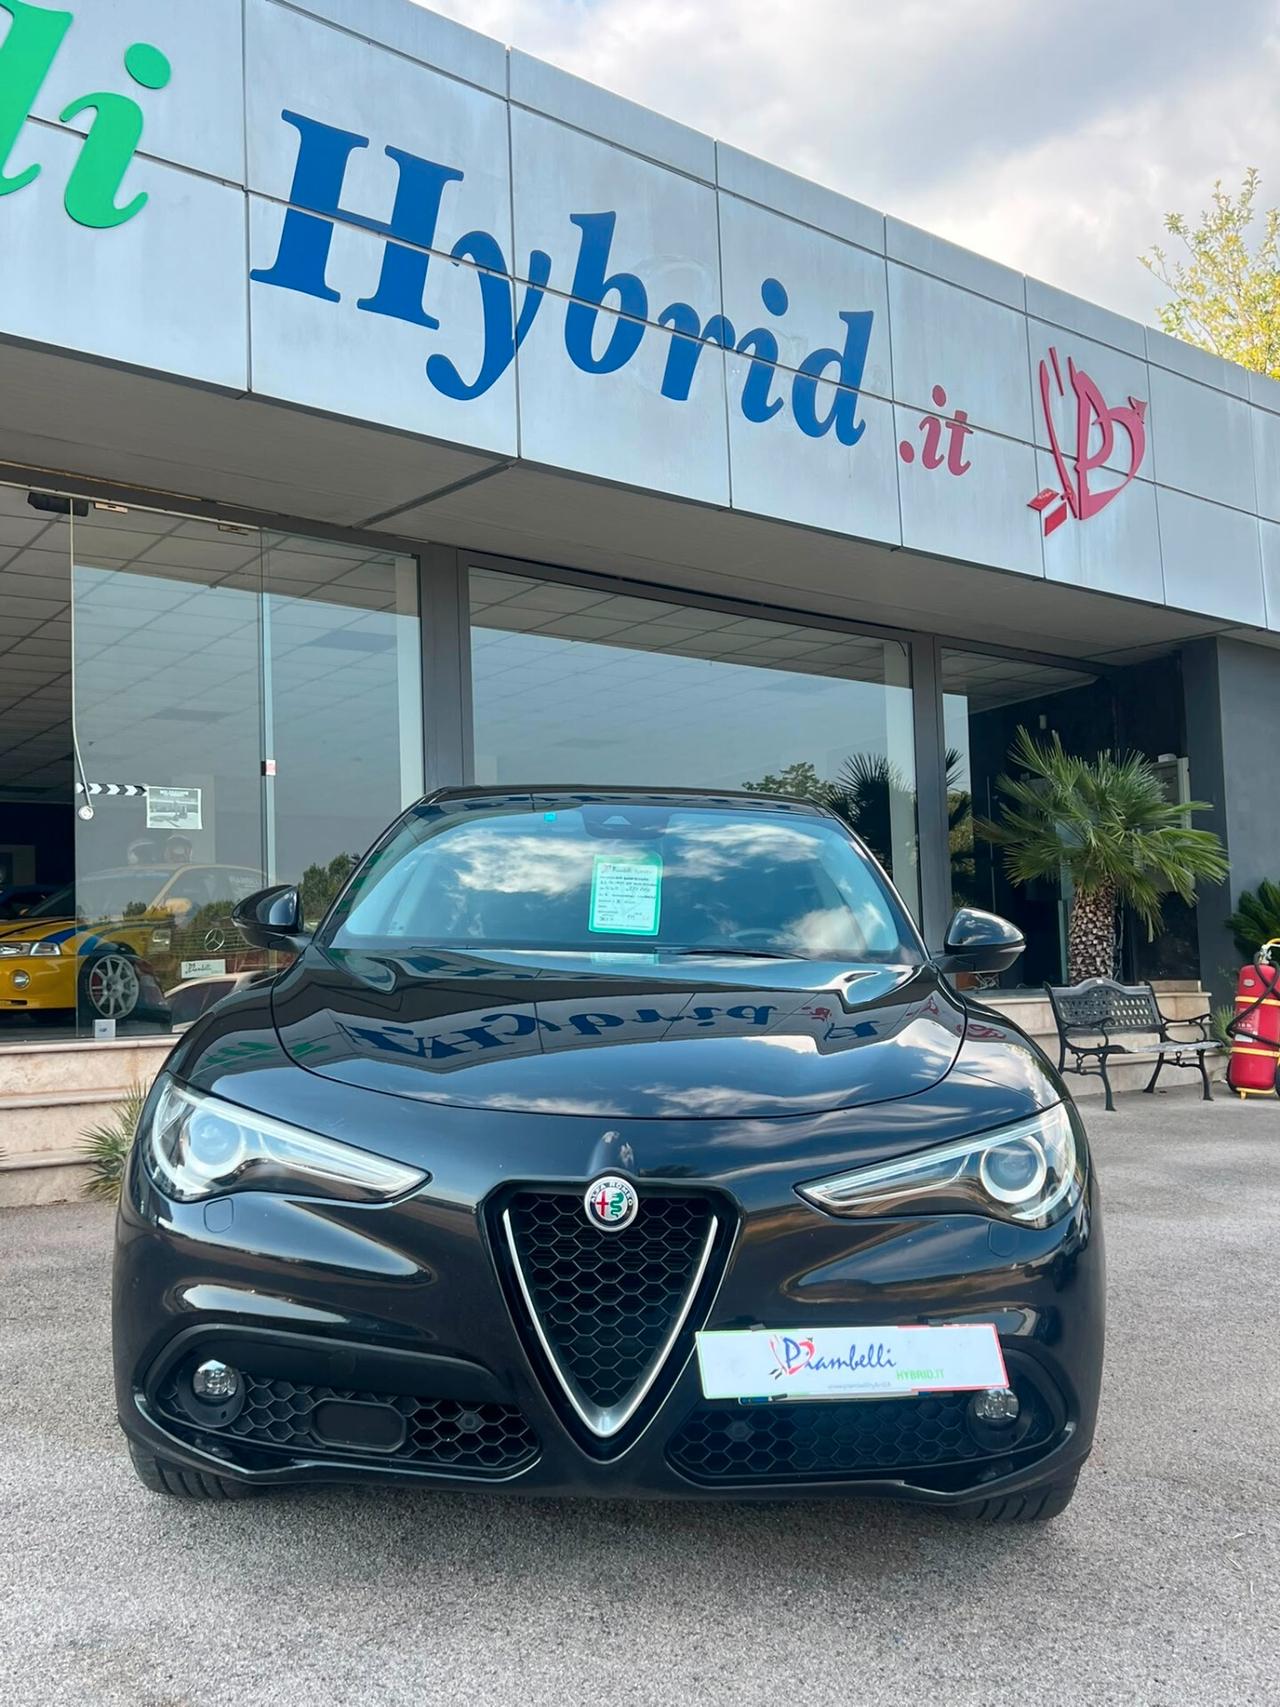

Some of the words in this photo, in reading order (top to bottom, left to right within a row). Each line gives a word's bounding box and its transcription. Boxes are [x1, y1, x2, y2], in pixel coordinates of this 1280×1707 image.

[249, 108, 874, 446] Hybrid
[783, 1337, 897, 1371] Piambelli
[896, 1368, 945, 1381] HYBRID.IT
